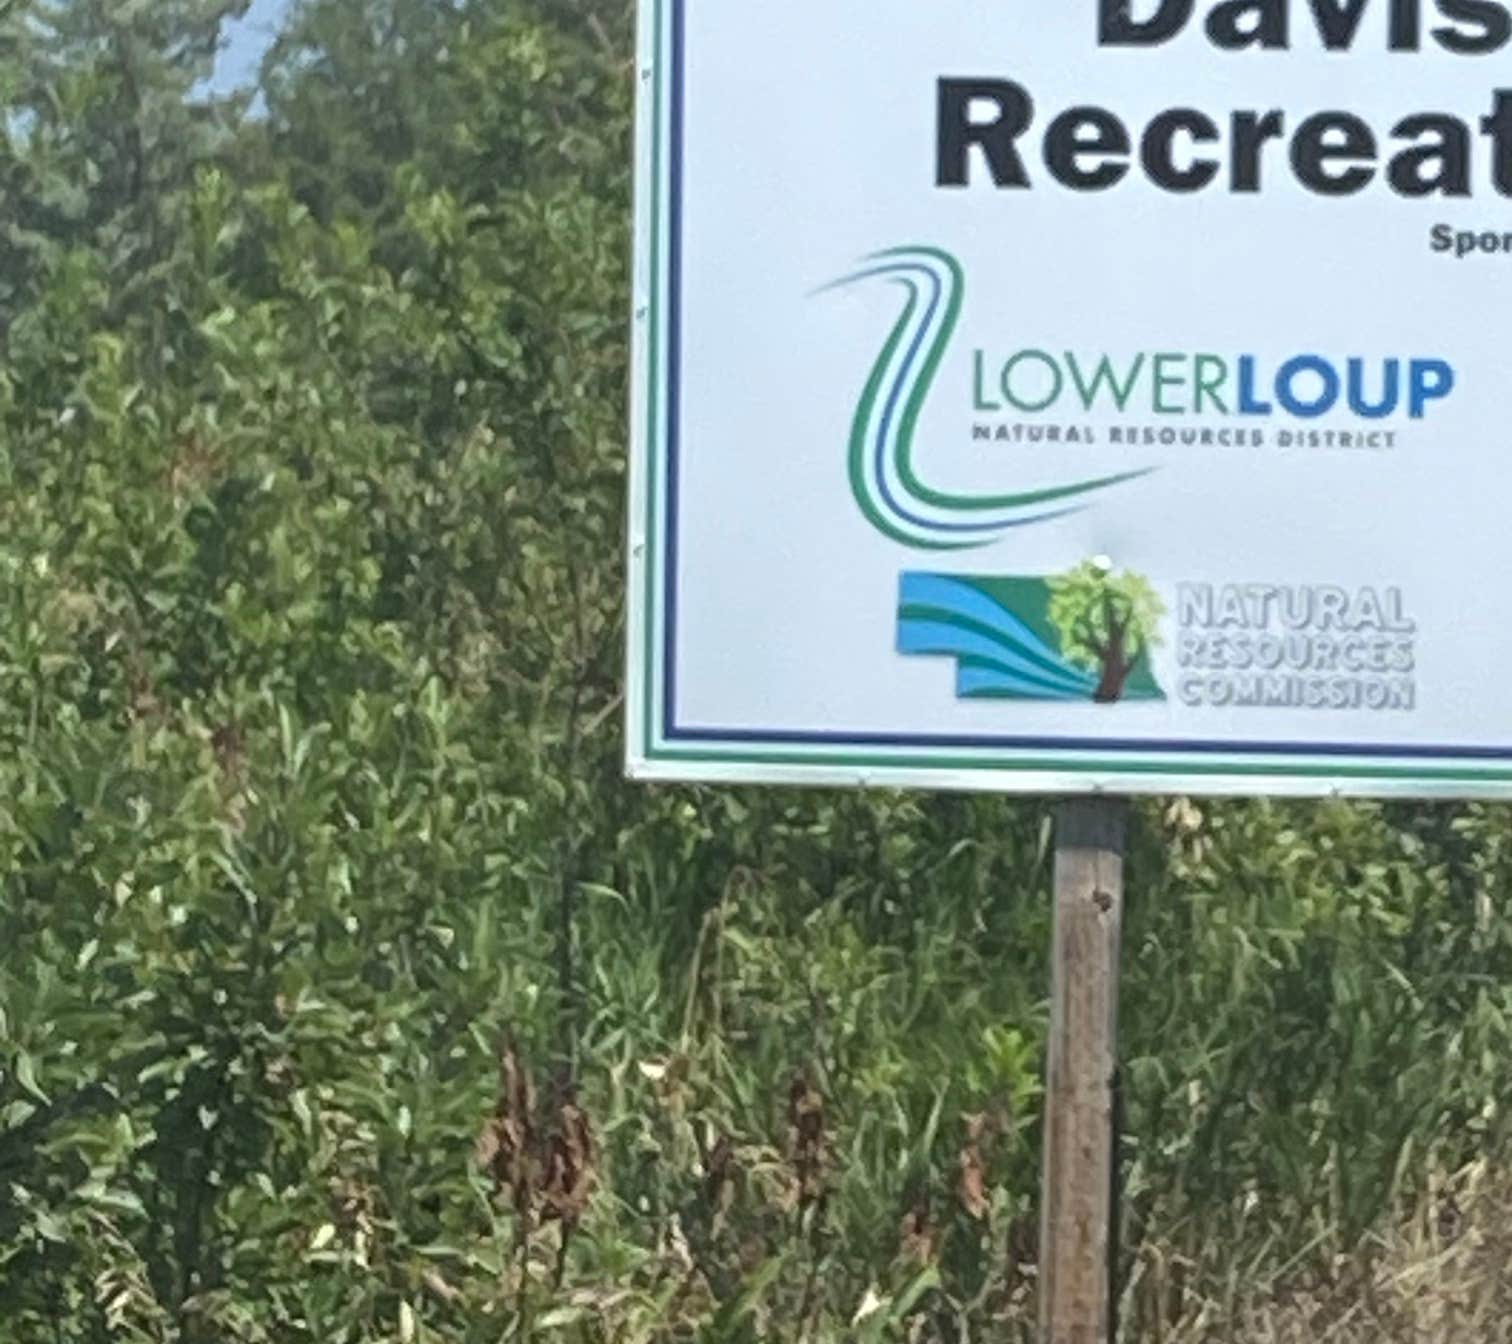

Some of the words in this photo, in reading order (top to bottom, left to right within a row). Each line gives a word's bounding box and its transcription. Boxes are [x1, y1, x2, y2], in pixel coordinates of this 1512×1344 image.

[972, 423, 1094, 445] NATURAL
[1108, 426, 1265, 448] RESOURCES
[1277, 429, 1395, 449] DISTRICT
[1180, 583, 1418, 632] NATURAL
[1180, 632, 1416, 671] RESOURCES
[1182, 675, 1416, 711] COMMISSION
